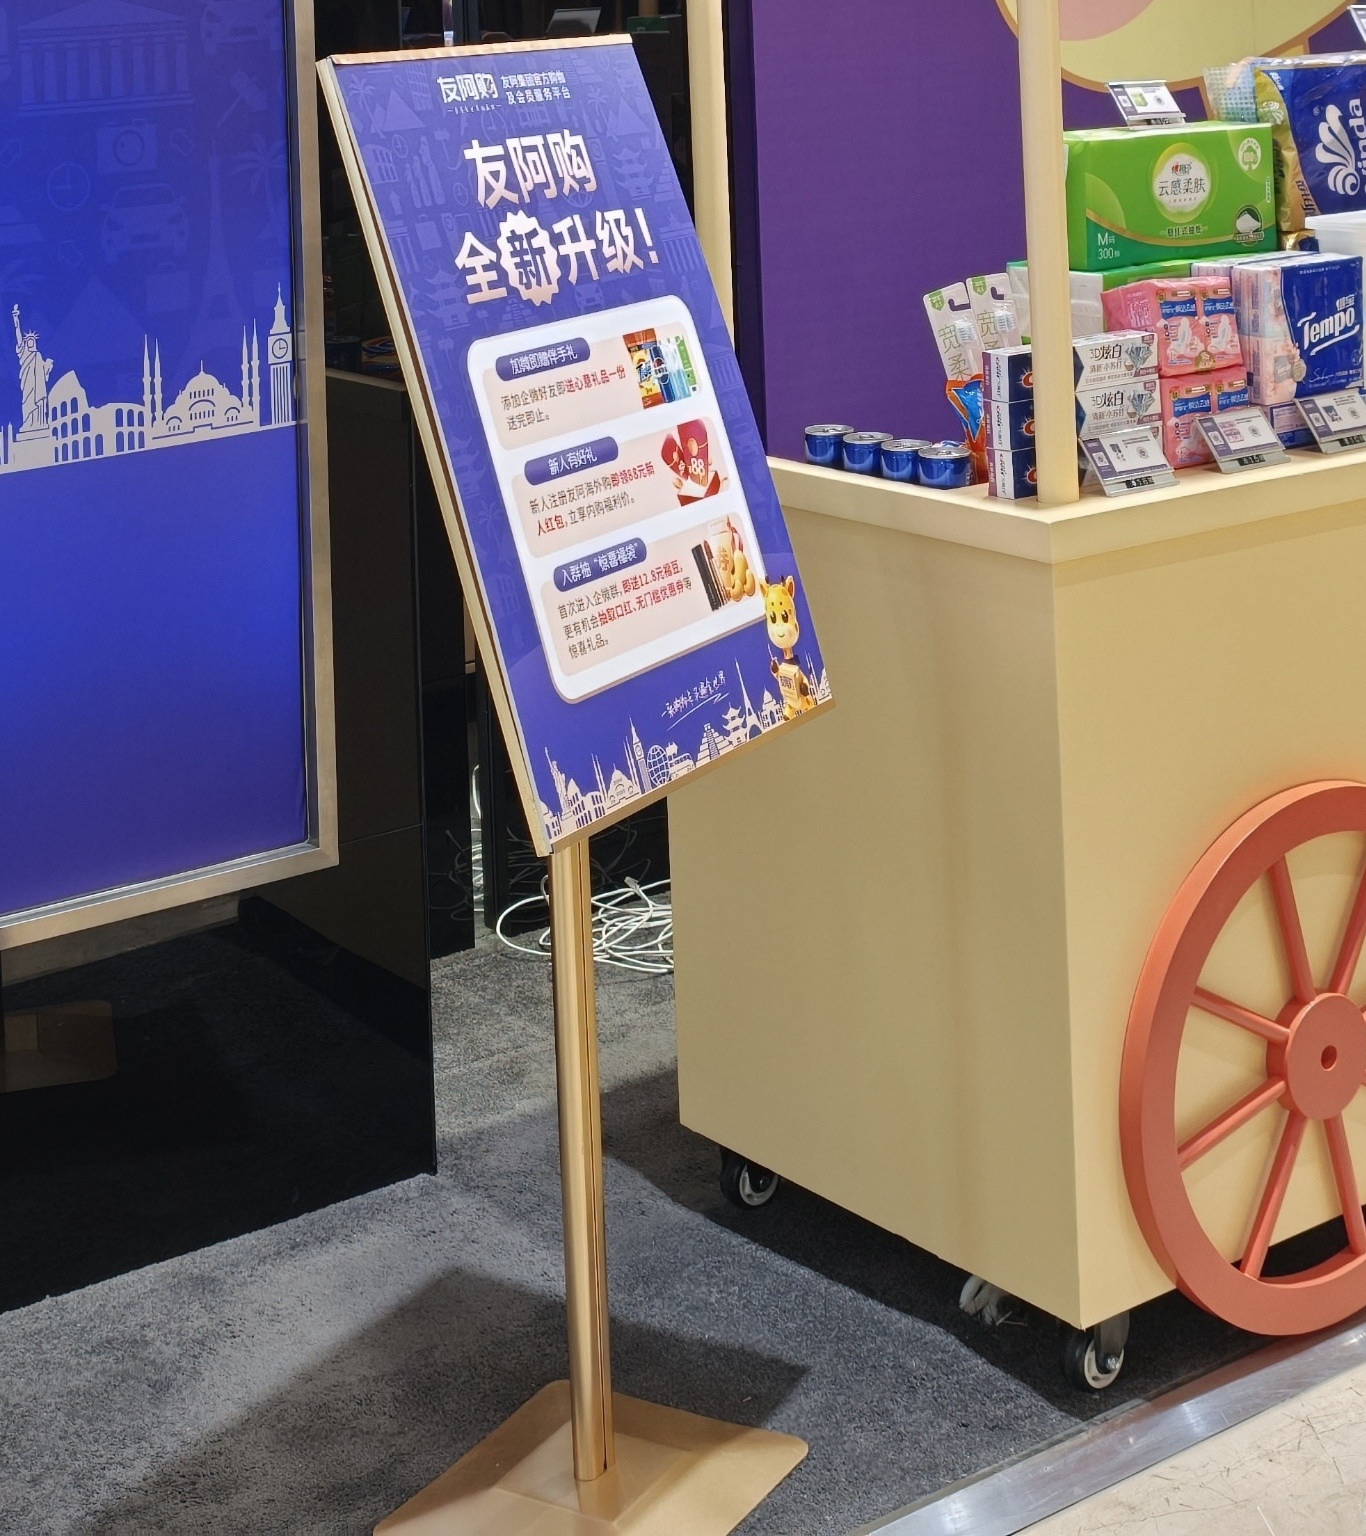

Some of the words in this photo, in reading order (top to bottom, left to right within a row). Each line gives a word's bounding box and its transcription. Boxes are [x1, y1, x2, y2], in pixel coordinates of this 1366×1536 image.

[436, 73, 499, 103] 友阿购
[463, 129, 598, 209] 友阿购
[1158, 177, 1206, 197] 云感柔肤
[1297, 307, 1356, 351] Tempo
[548, 446, 598, 476] 新人有好礼
